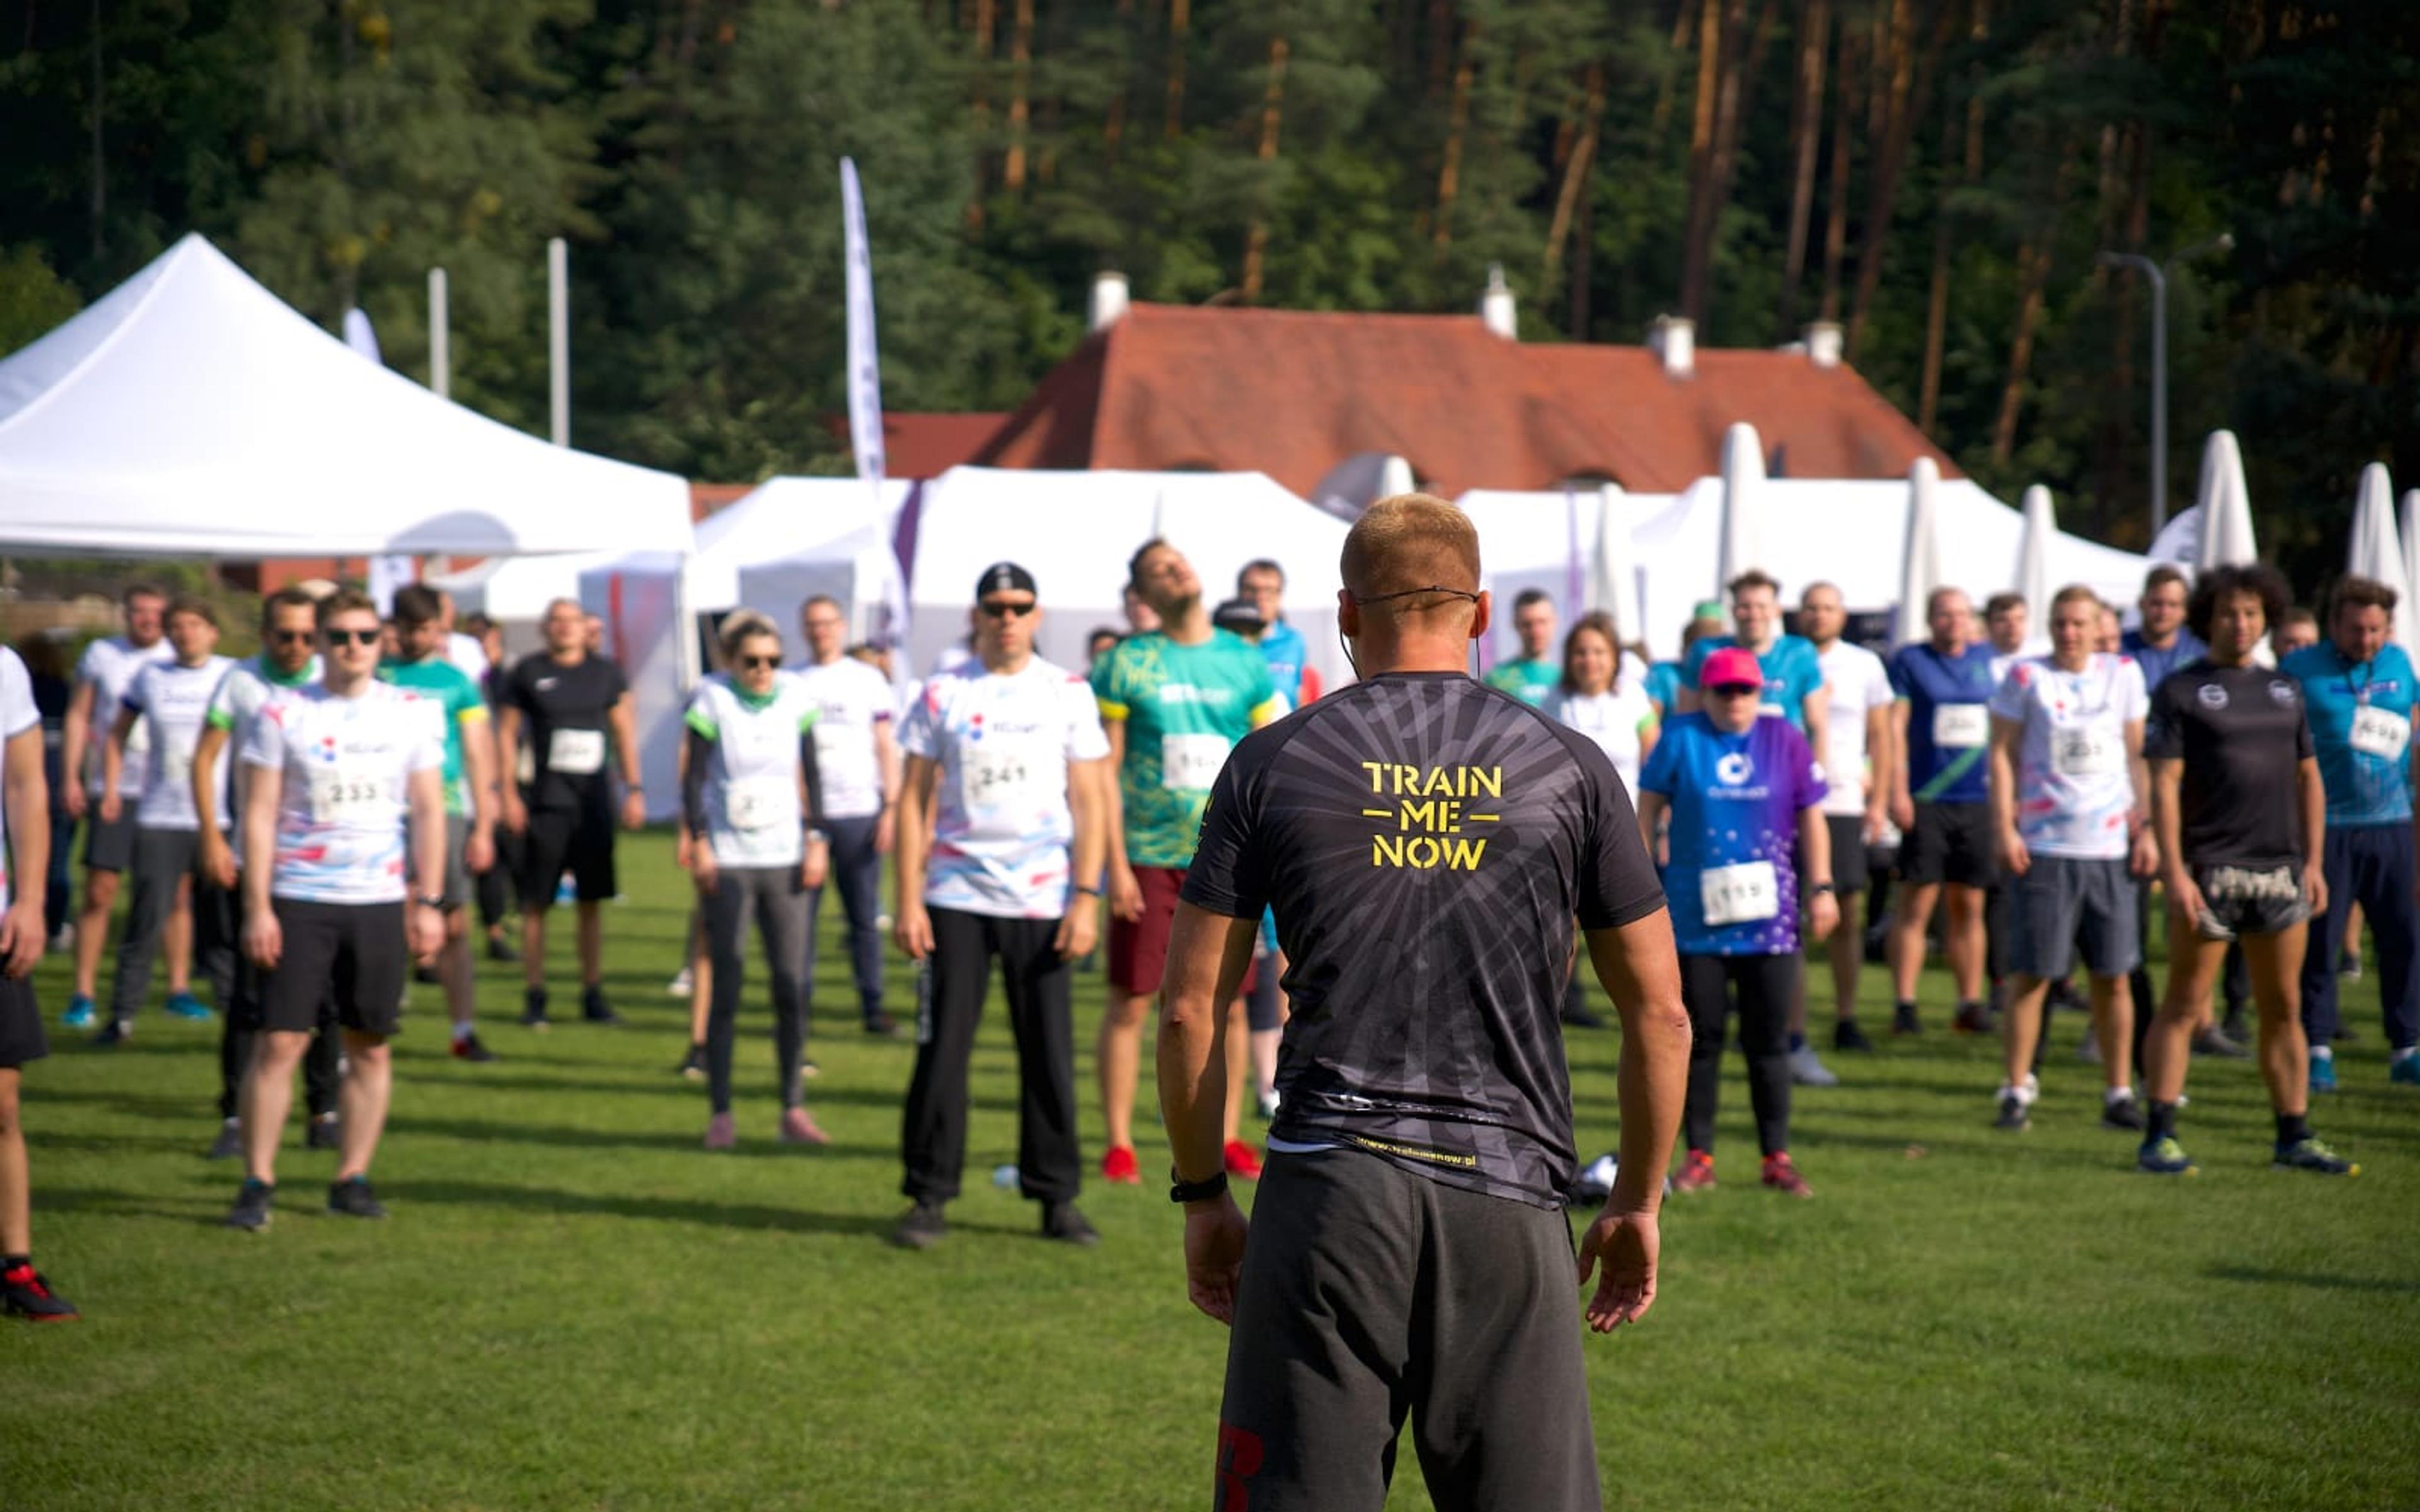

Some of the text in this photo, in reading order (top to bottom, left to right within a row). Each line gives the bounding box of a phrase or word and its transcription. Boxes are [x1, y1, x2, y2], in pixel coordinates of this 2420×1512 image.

[329, 783, 377, 803] 233
[1362, 762, 1502, 798] TRAIN
[1400, 799, 1461, 833] ME
[1373, 834, 1487, 871] NOW
